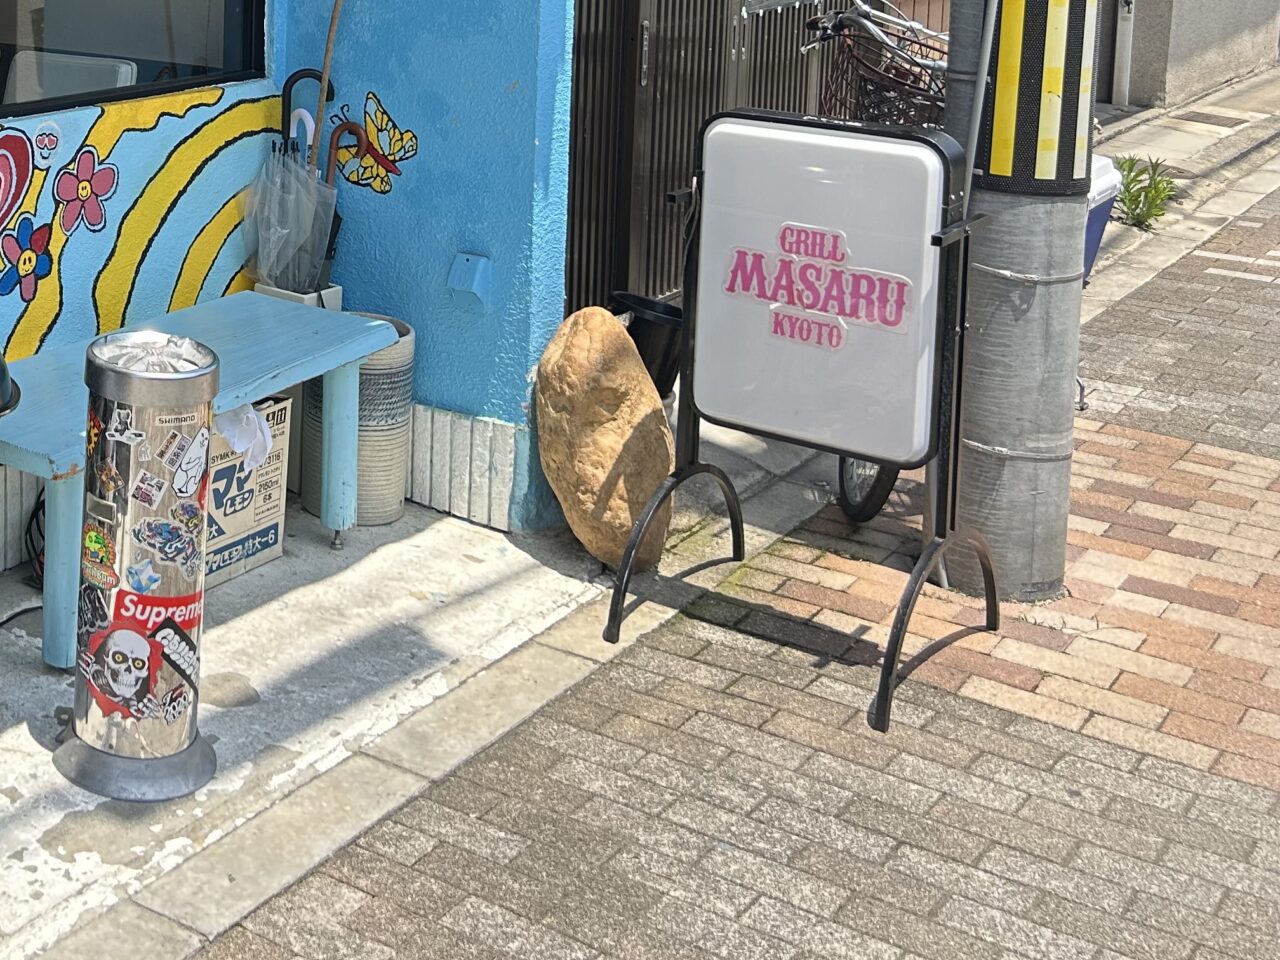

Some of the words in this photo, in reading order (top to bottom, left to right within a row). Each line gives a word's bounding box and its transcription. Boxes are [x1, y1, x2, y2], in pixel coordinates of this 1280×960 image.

[778, 225, 846, 263] GRILL
[724, 249, 909, 327] MASARU
[772, 311, 843, 349] KYOTO
[158, 414, 196, 425] SHIMANO
